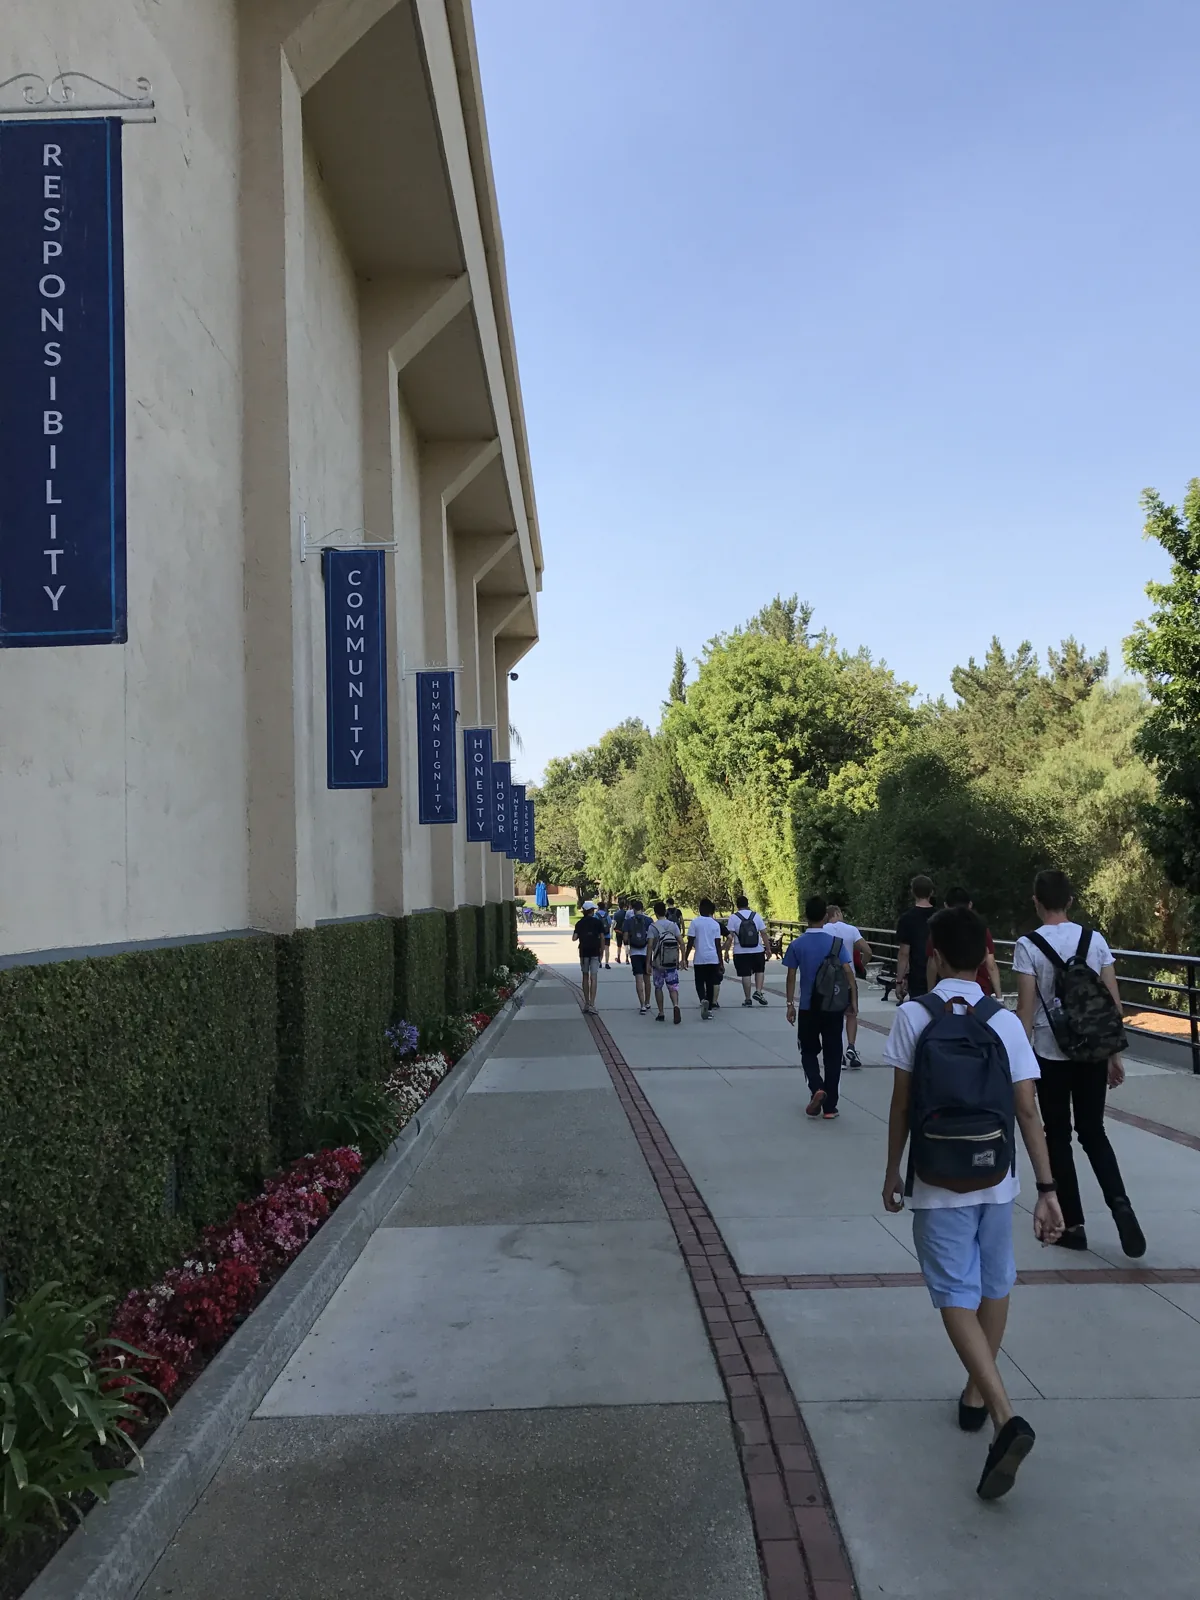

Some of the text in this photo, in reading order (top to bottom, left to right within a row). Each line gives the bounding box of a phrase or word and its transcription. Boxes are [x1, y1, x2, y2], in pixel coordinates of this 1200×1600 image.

[38, 143, 66, 612] RESPONSIBILITY
[346, 570, 365, 766] COMMUNITY
[431, 680, 442, 814] HUMAN DIGNITY
[473, 739, 485, 832] HONESTY
[496, 781, 505, 833] HONOR
